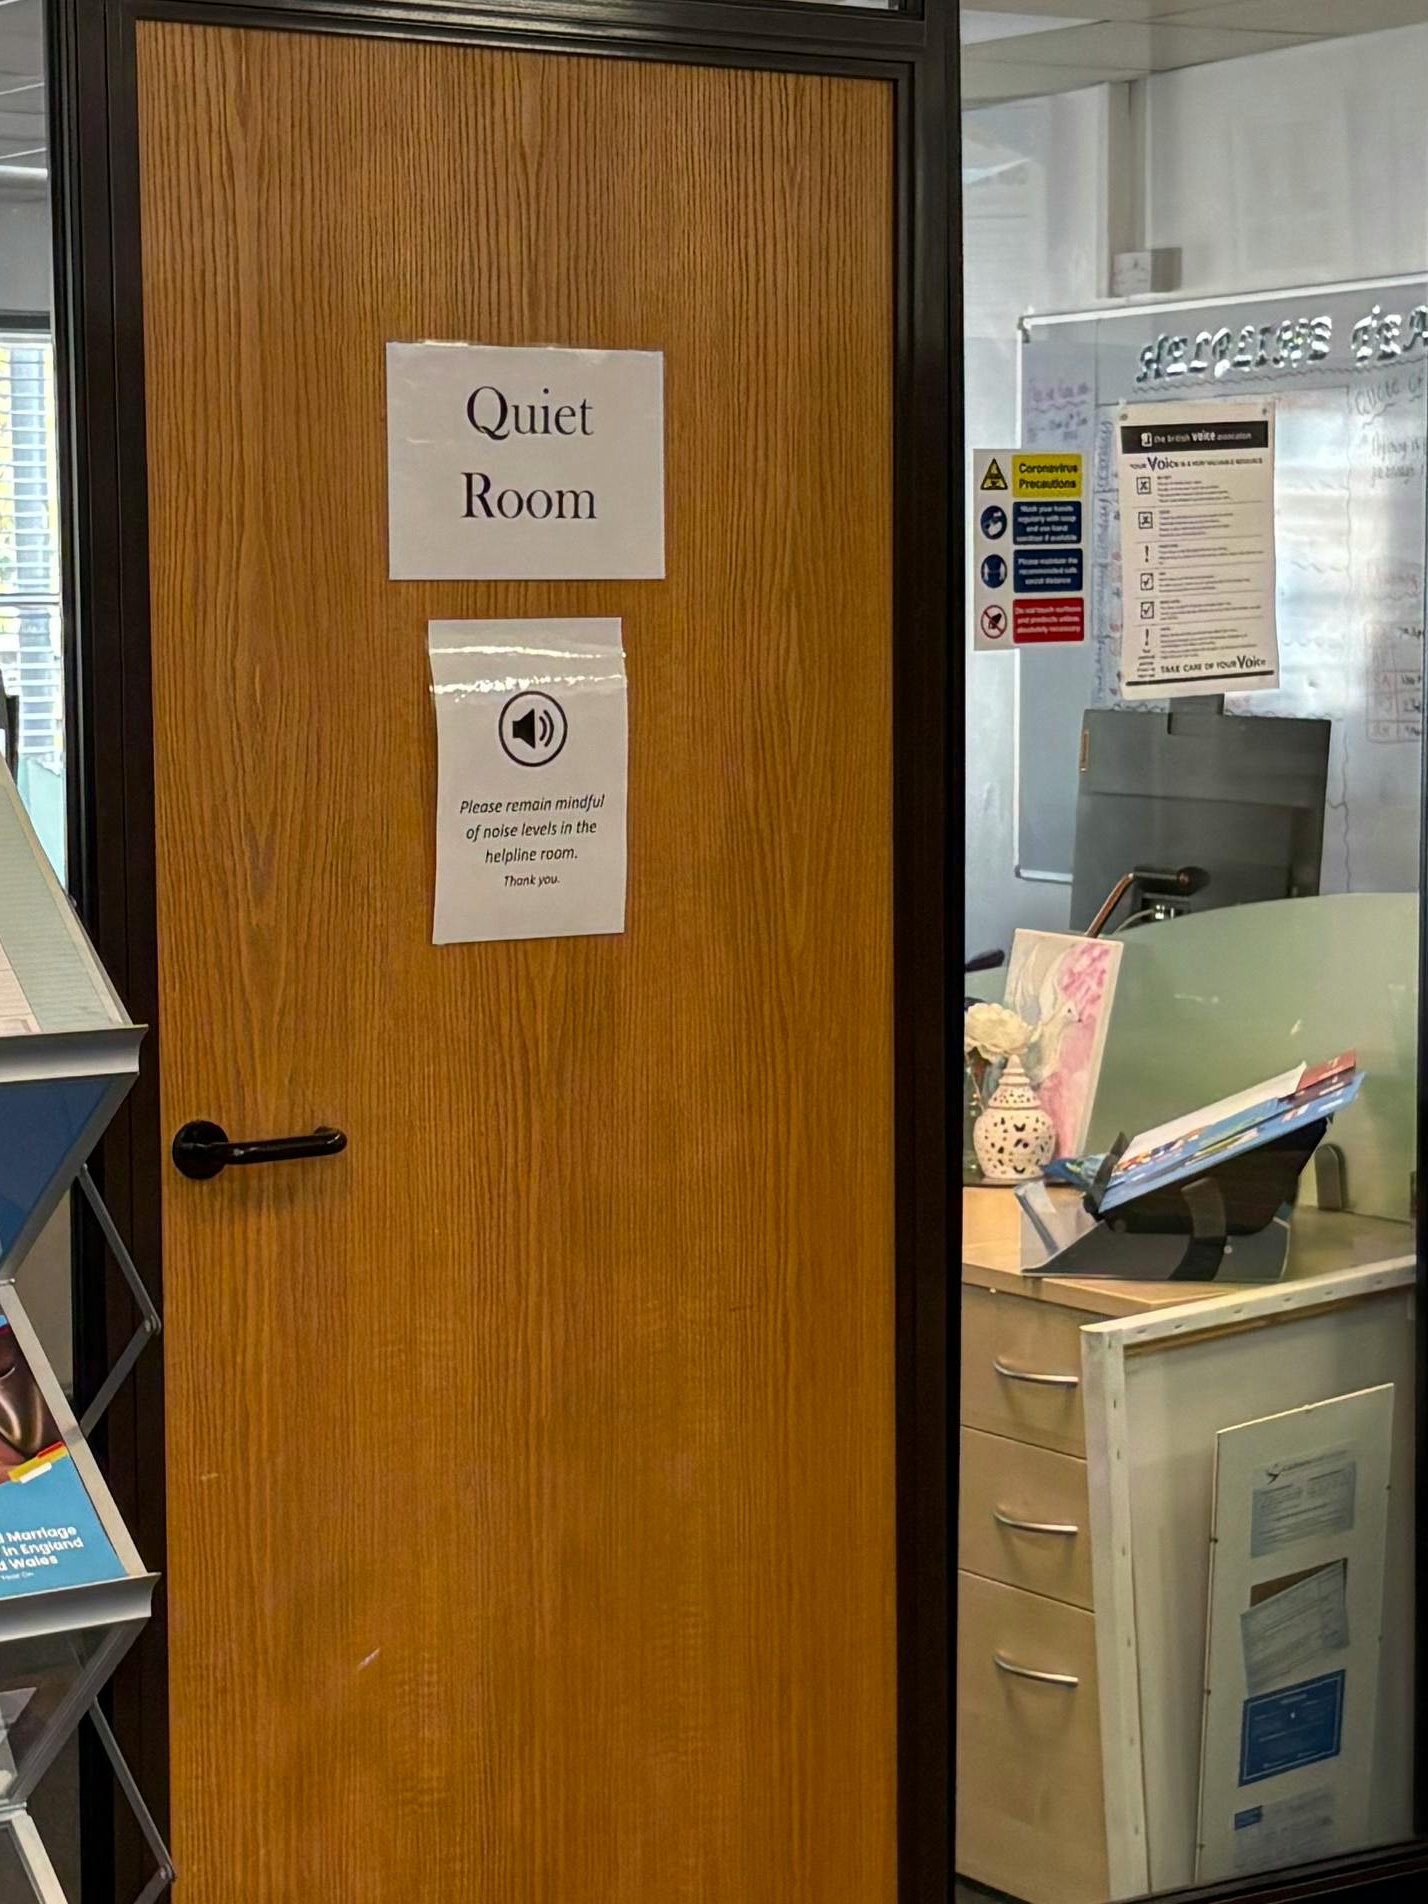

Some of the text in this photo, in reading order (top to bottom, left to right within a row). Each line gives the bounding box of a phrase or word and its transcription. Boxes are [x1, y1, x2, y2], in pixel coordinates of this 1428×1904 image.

[467, 386, 594, 440] Quiet
[1191, 429, 1216, 442] voice
[1019, 462, 1078, 475] Coronavirus
[1019, 478, 1077, 490] Precautions
[460, 472, 597, 519] Room
[1236, 654, 1267, 670] Voice
[460, 793, 605, 814] Please remain mindful
[466, 819, 597, 843] of noise levels in the
[484, 847, 578, 866] helpline room.
[504, 874, 560, 888] Thank you.
[6, 1526, 77, 1542] Marriage
[2, 1544, 19, 1557] in
[20, 1537, 84, 1555] England
[9, 1554, 59, 1570] Wales
